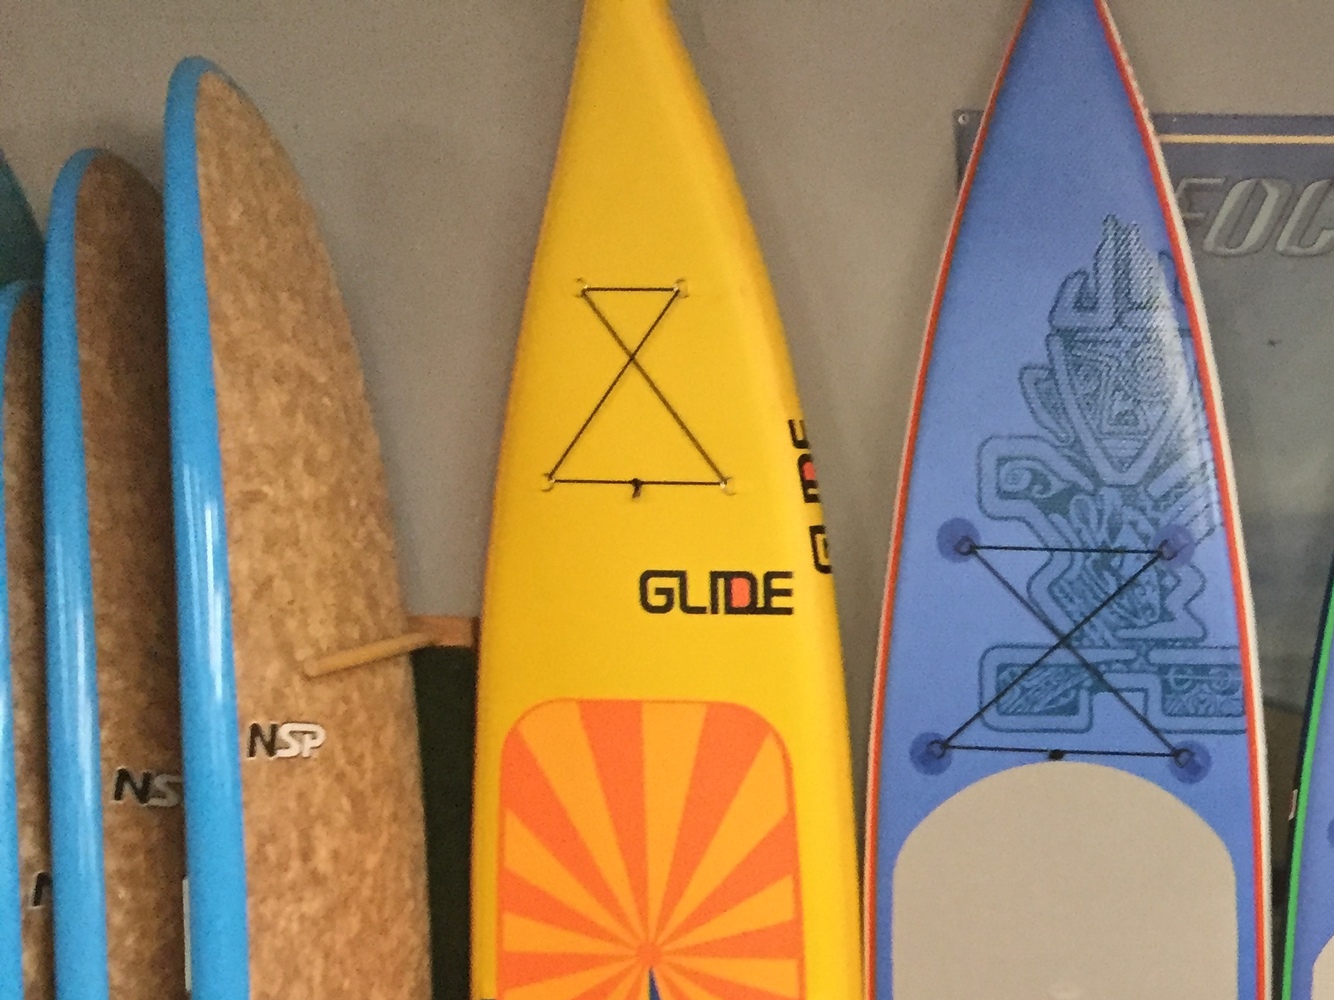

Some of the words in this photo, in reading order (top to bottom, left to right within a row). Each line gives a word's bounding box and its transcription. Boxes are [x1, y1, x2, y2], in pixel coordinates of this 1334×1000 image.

[639, 569, 794, 615] GLIDE
[247, 722, 326, 758] NSP
[112, 766, 184, 807] NS
